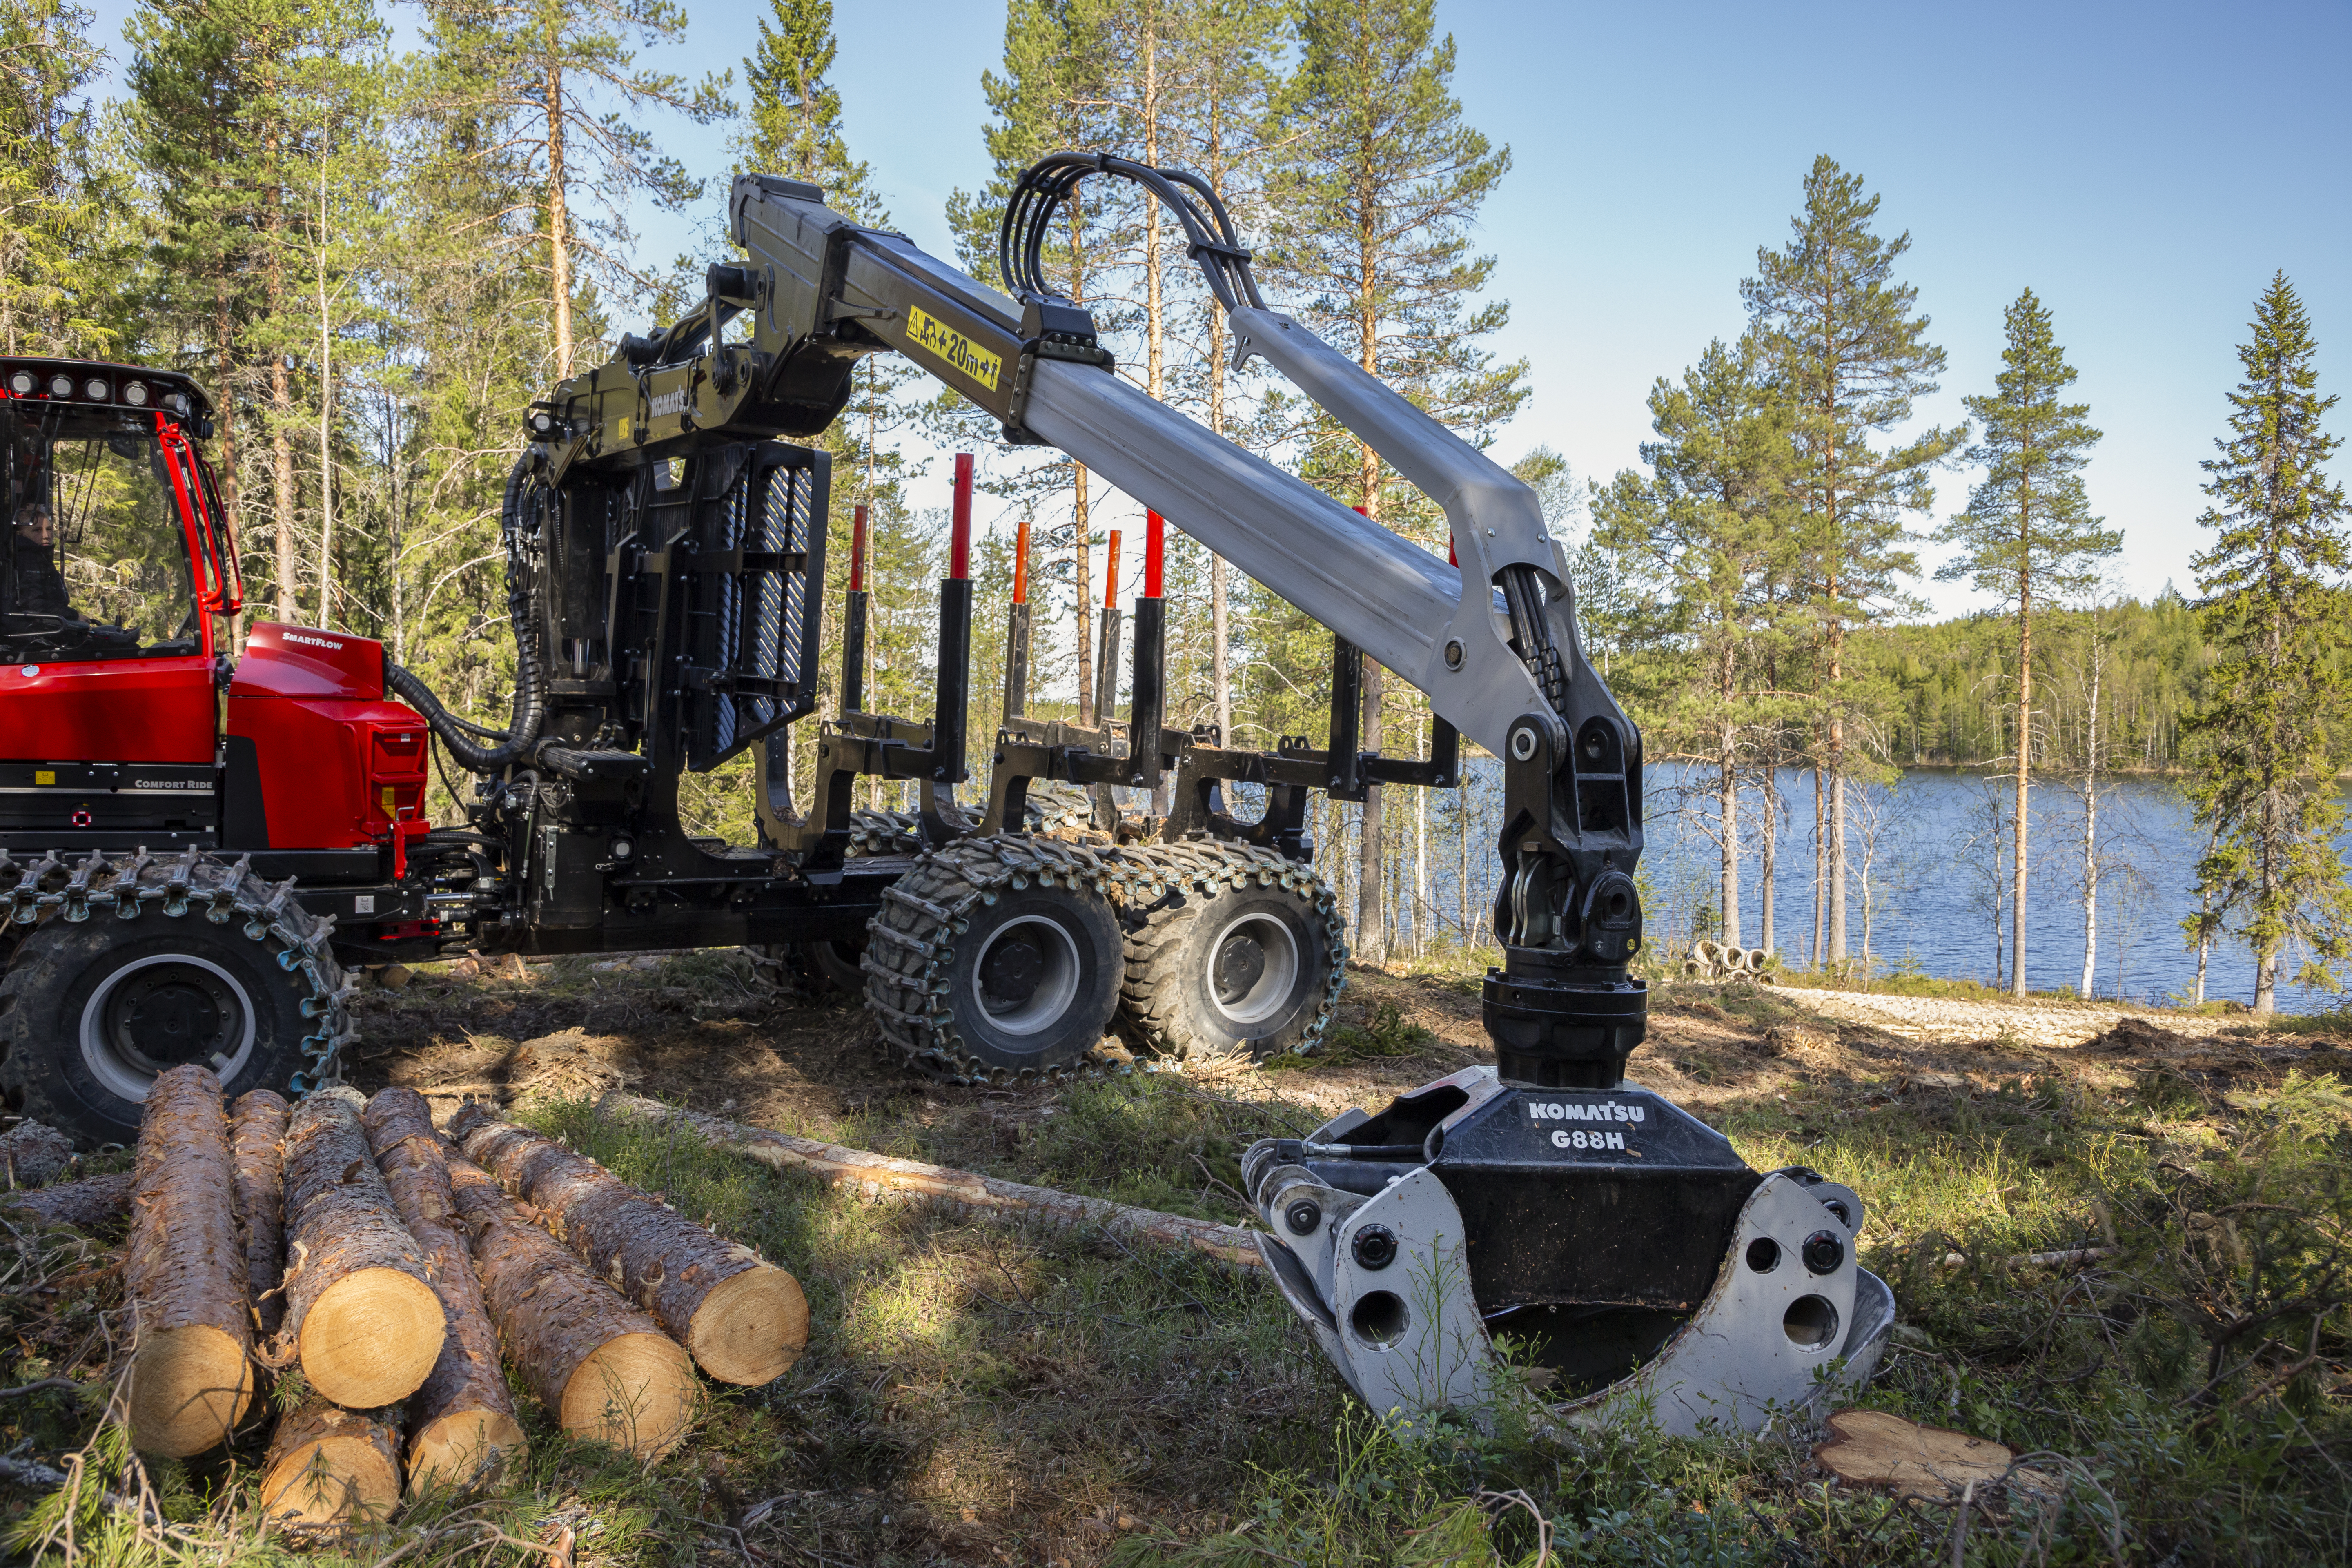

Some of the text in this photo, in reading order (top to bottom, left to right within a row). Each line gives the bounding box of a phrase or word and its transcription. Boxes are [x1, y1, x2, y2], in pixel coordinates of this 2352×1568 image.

[947, 333, 978, 376] 20m
[282, 632, 343, 650] SMARTFLOW
[135, 780, 212, 788] COMFORT RIDE
[1529, 1101, 1645, 1122] KOMATSU
[1551, 1130, 1625, 1149] G88H
